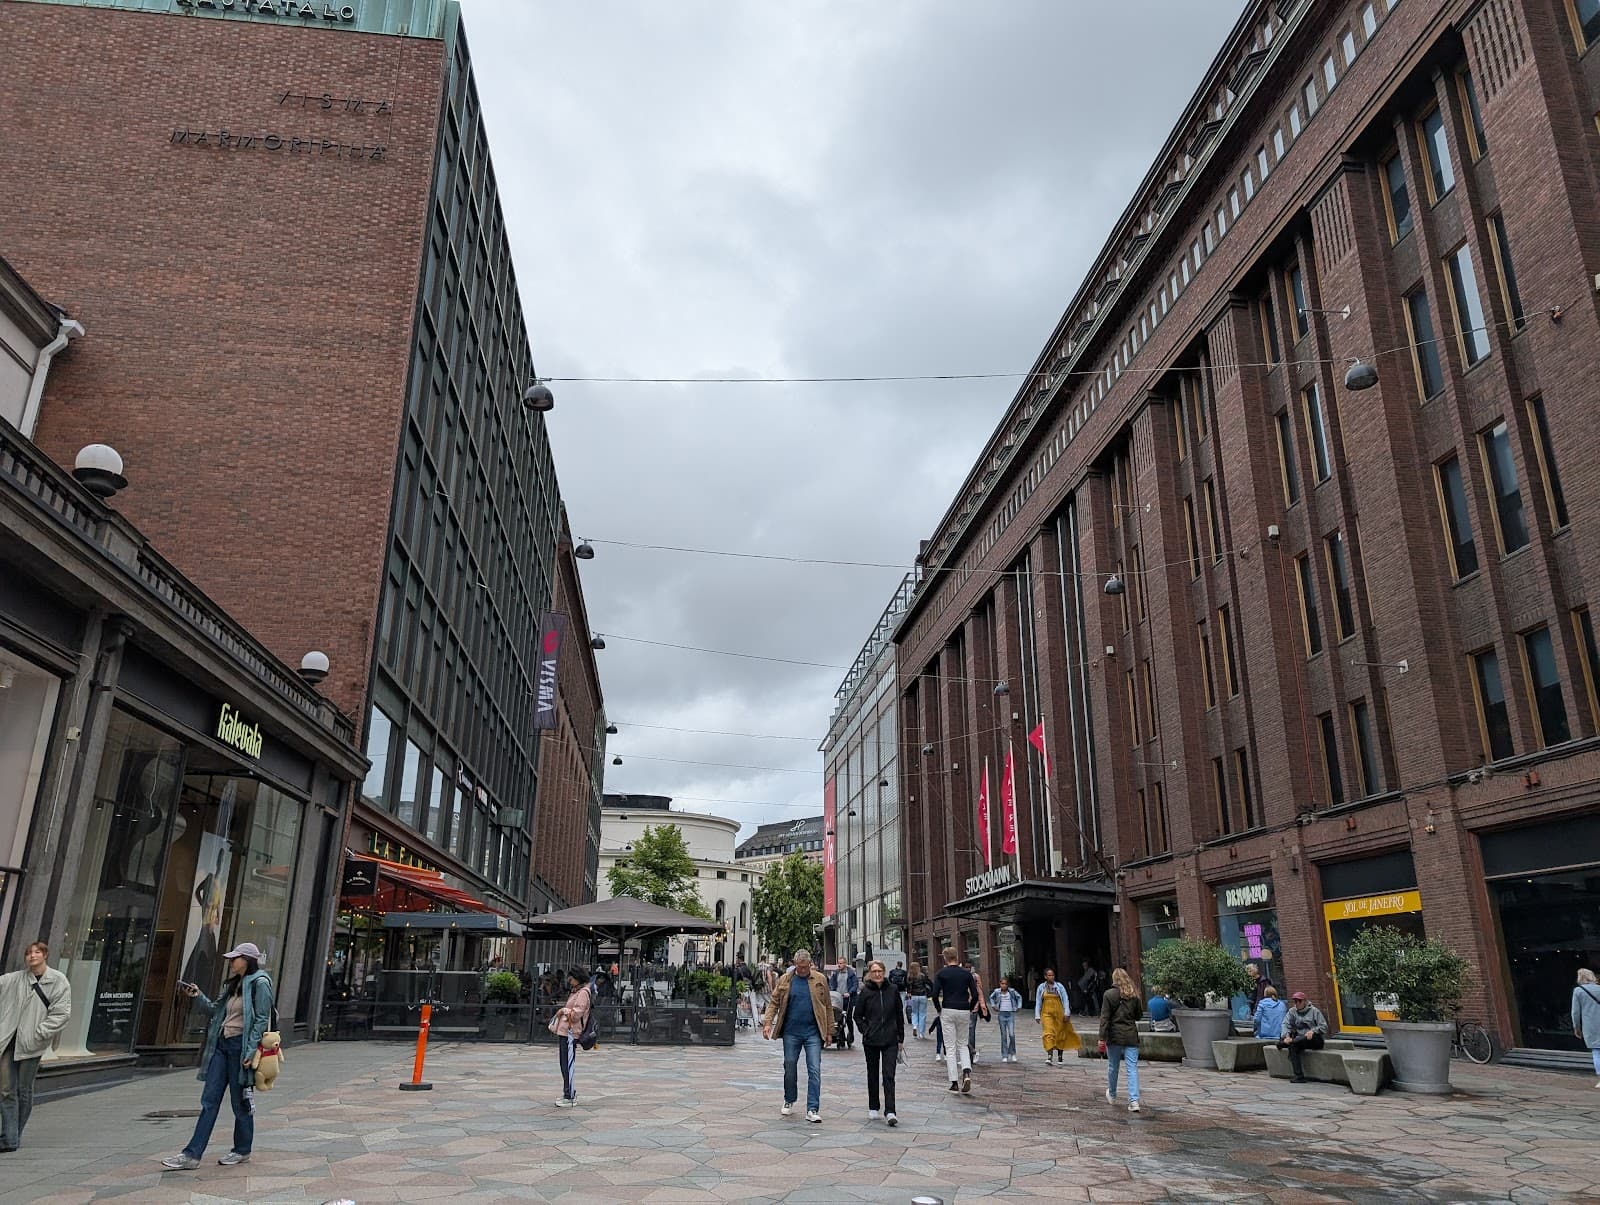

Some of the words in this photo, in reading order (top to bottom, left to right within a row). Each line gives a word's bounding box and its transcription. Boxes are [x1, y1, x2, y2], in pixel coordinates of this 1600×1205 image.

[538, 659, 557, 712] VISMA
[965, 864, 1010, 895] STOCKMANN
[1343, 902, 1358, 917] SOL
